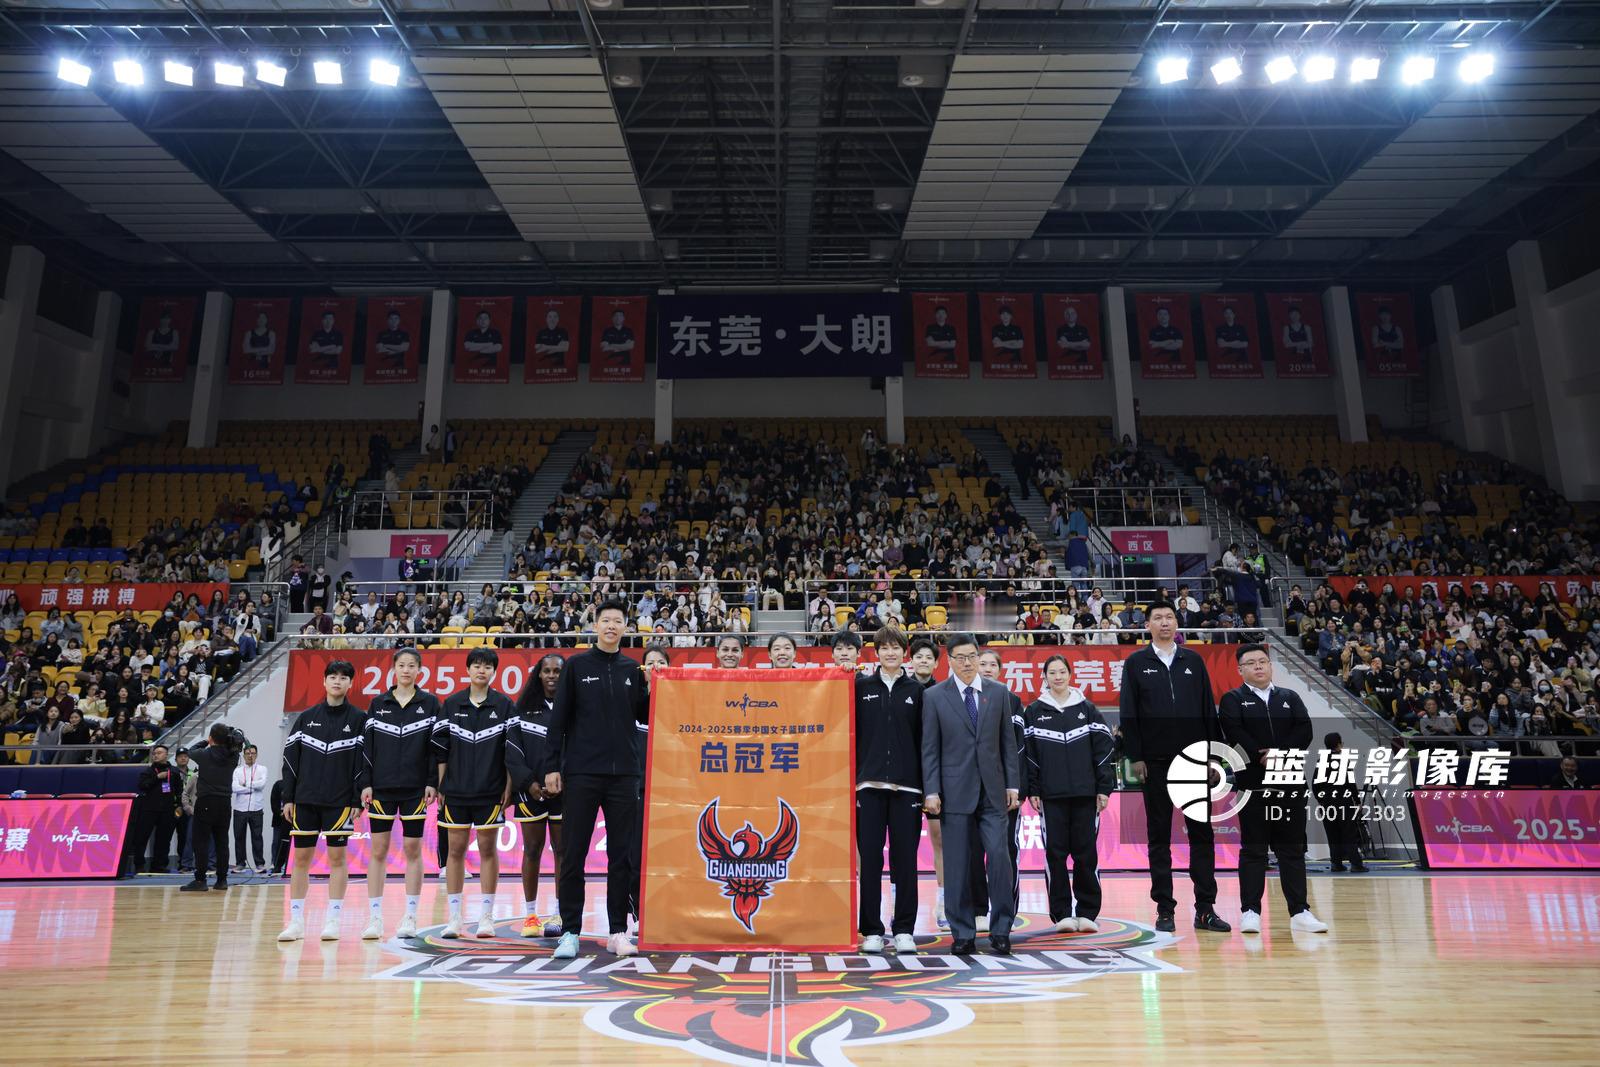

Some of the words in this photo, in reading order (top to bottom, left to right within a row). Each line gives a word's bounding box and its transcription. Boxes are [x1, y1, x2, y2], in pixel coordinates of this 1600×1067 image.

[669, 313, 892, 357] 东莞·大朗
[1127, 541, 1153, 551] 西区
[40, 588, 136, 605] 顽强拼搏
[700, 741, 800, 773] 总冠军
[0, 828, 31, 852] 赛
[1513, 818, 1600, 841] 2025-
[709, 859, 786, 878] GUANGDONG
[418, 950, 1141, 975] GUANGDONG
